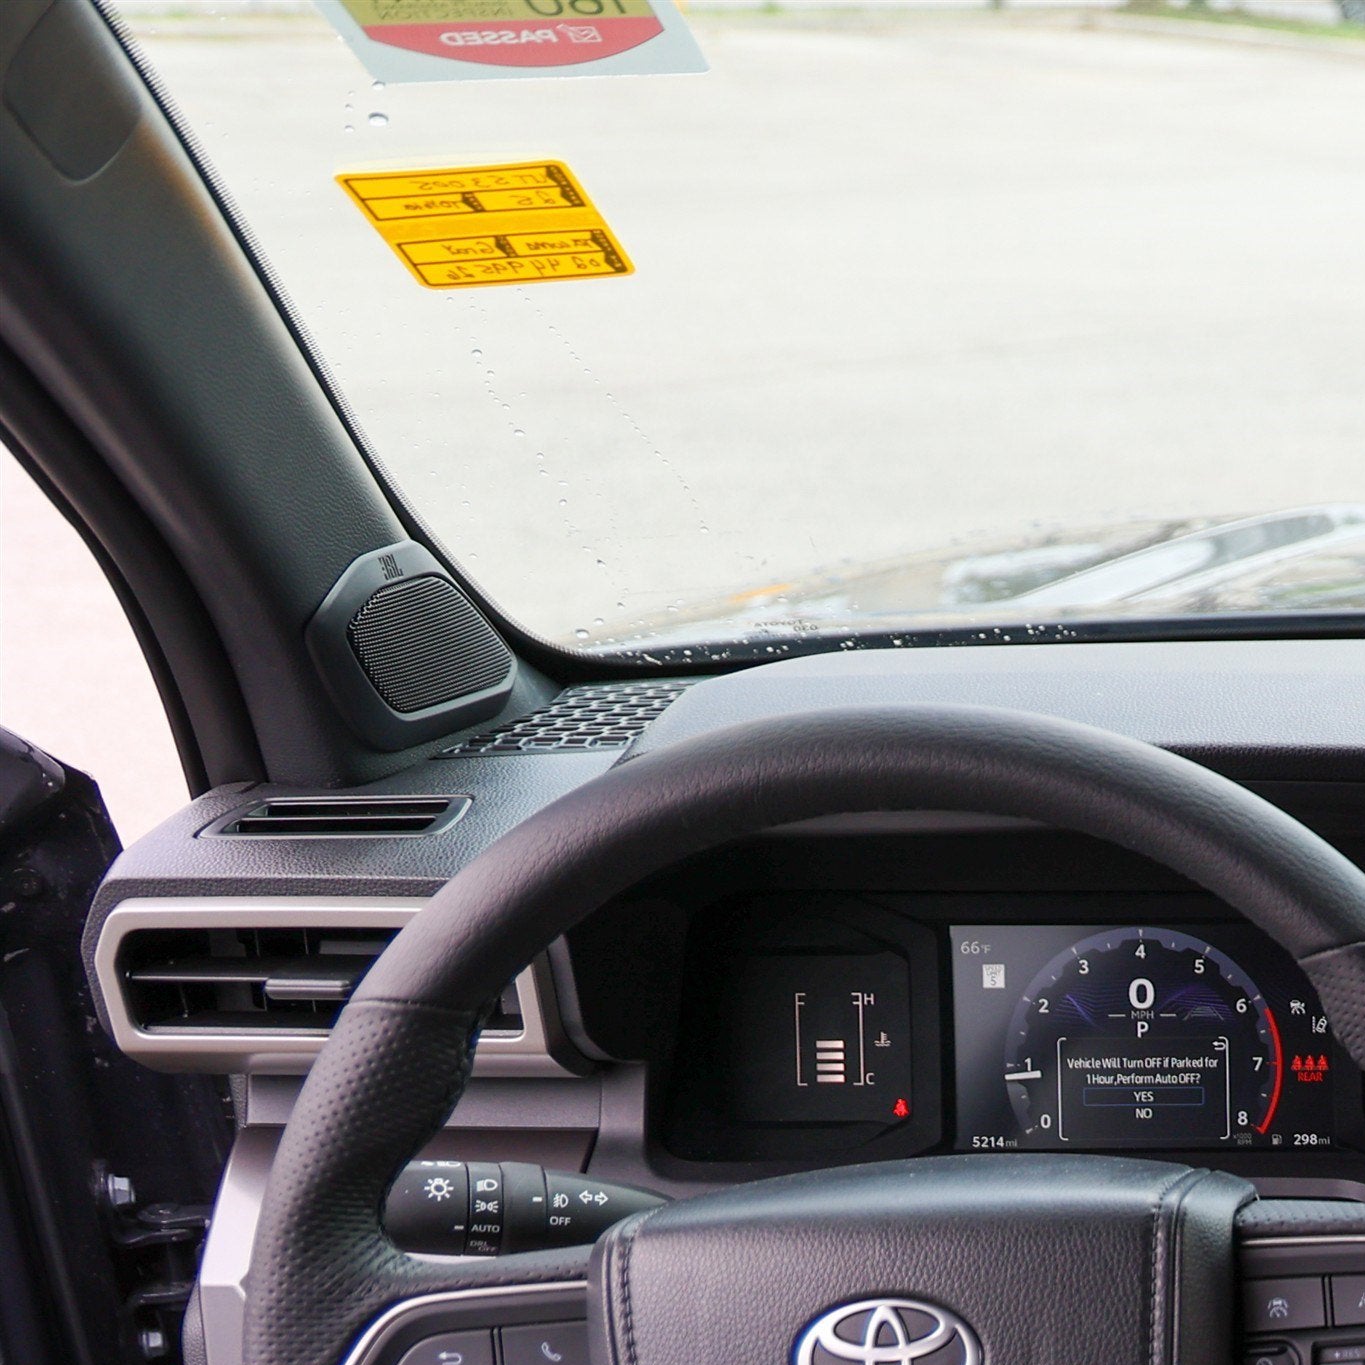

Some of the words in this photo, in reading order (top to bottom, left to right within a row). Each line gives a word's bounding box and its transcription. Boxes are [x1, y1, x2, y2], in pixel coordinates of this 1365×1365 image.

[378, 554, 404, 580] JBL
[1135, 944, 1146, 959] 4
[1078, 960, 1089, 974] 3
[1194, 960, 1205, 974] 5
[864, 993, 875, 1005] H
[1128, 978, 1155, 1009] 0
[1038, 999, 1049, 1013] 2
[1235, 998, 1247, 1013] 6
[1130, 1010, 1154, 1020] MPH
[1136, 1022, 1149, 1038] P
[1024, 1058, 1031, 1071] 1
[1067, 1058, 1100, 1068] Vehicle
[1101, 1058, 1120, 1068] Will
[1123, 1058, 1143, 1068] Turn
[1144, 1058, 1162, 1068] OFF
[1162, 1058, 1169, 1068] if
[1171, 1058, 1204, 1068] Parked
[1205, 1058, 1219, 1068] for
[1252, 1057, 1263, 1071] 7
[866, 1073, 875, 1085] C
[1155, 1074, 1177, 1084] Auto
[1178, 1074, 1201, 1084] OFF?
[1297, 1073, 1323, 1082] REAR
[1133, 1091, 1154, 1102] YES
[1135, 1108, 1152, 1119] NO
[1237, 1111, 1248, 1125] 8
[1040, 1114, 1051, 1129] 0
[549, 1216, 571, 1226] OFF
[471, 1224, 500, 1233] AUTO
